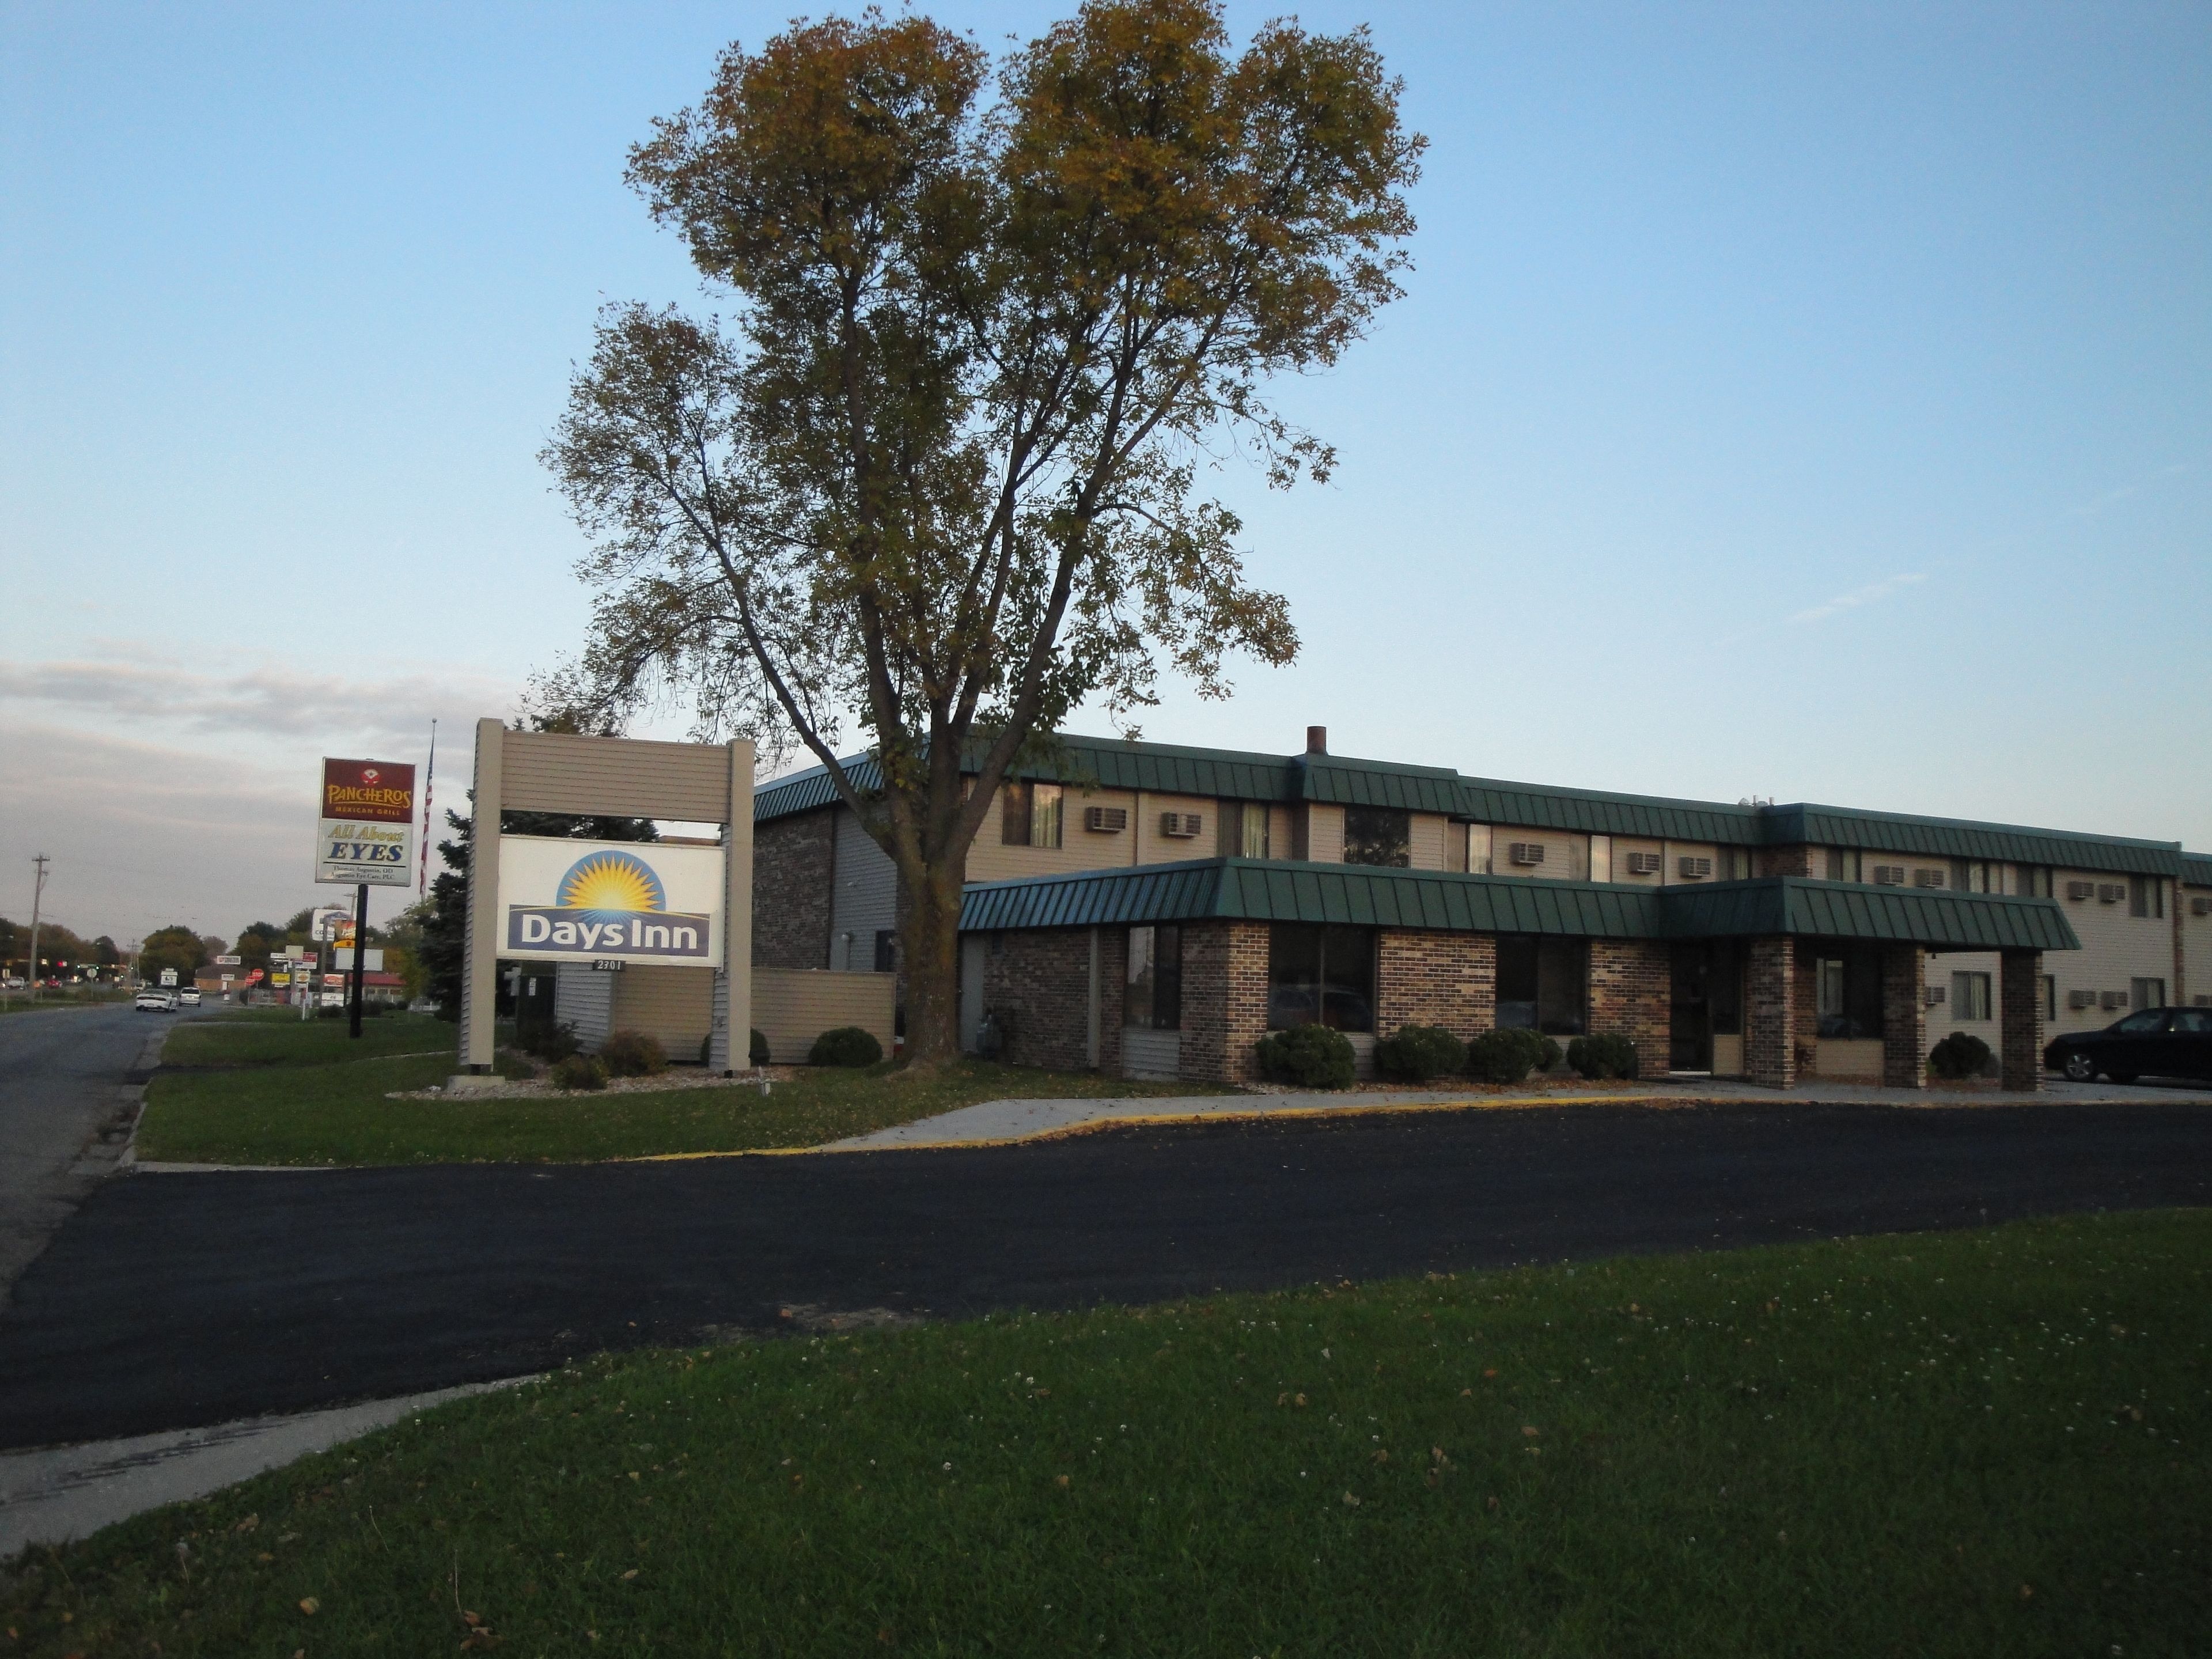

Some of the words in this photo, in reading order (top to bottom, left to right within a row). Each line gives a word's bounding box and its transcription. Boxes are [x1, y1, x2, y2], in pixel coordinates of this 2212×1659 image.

[328, 784, 411, 808] PANCHEROS
[328, 824, 355, 839] All
[355, 825, 404, 842] About
[328, 842, 404, 862] EYES
[521, 914, 624, 950] Days
[631, 919, 698, 949] Inn
[597, 960, 621, 969] 2301
